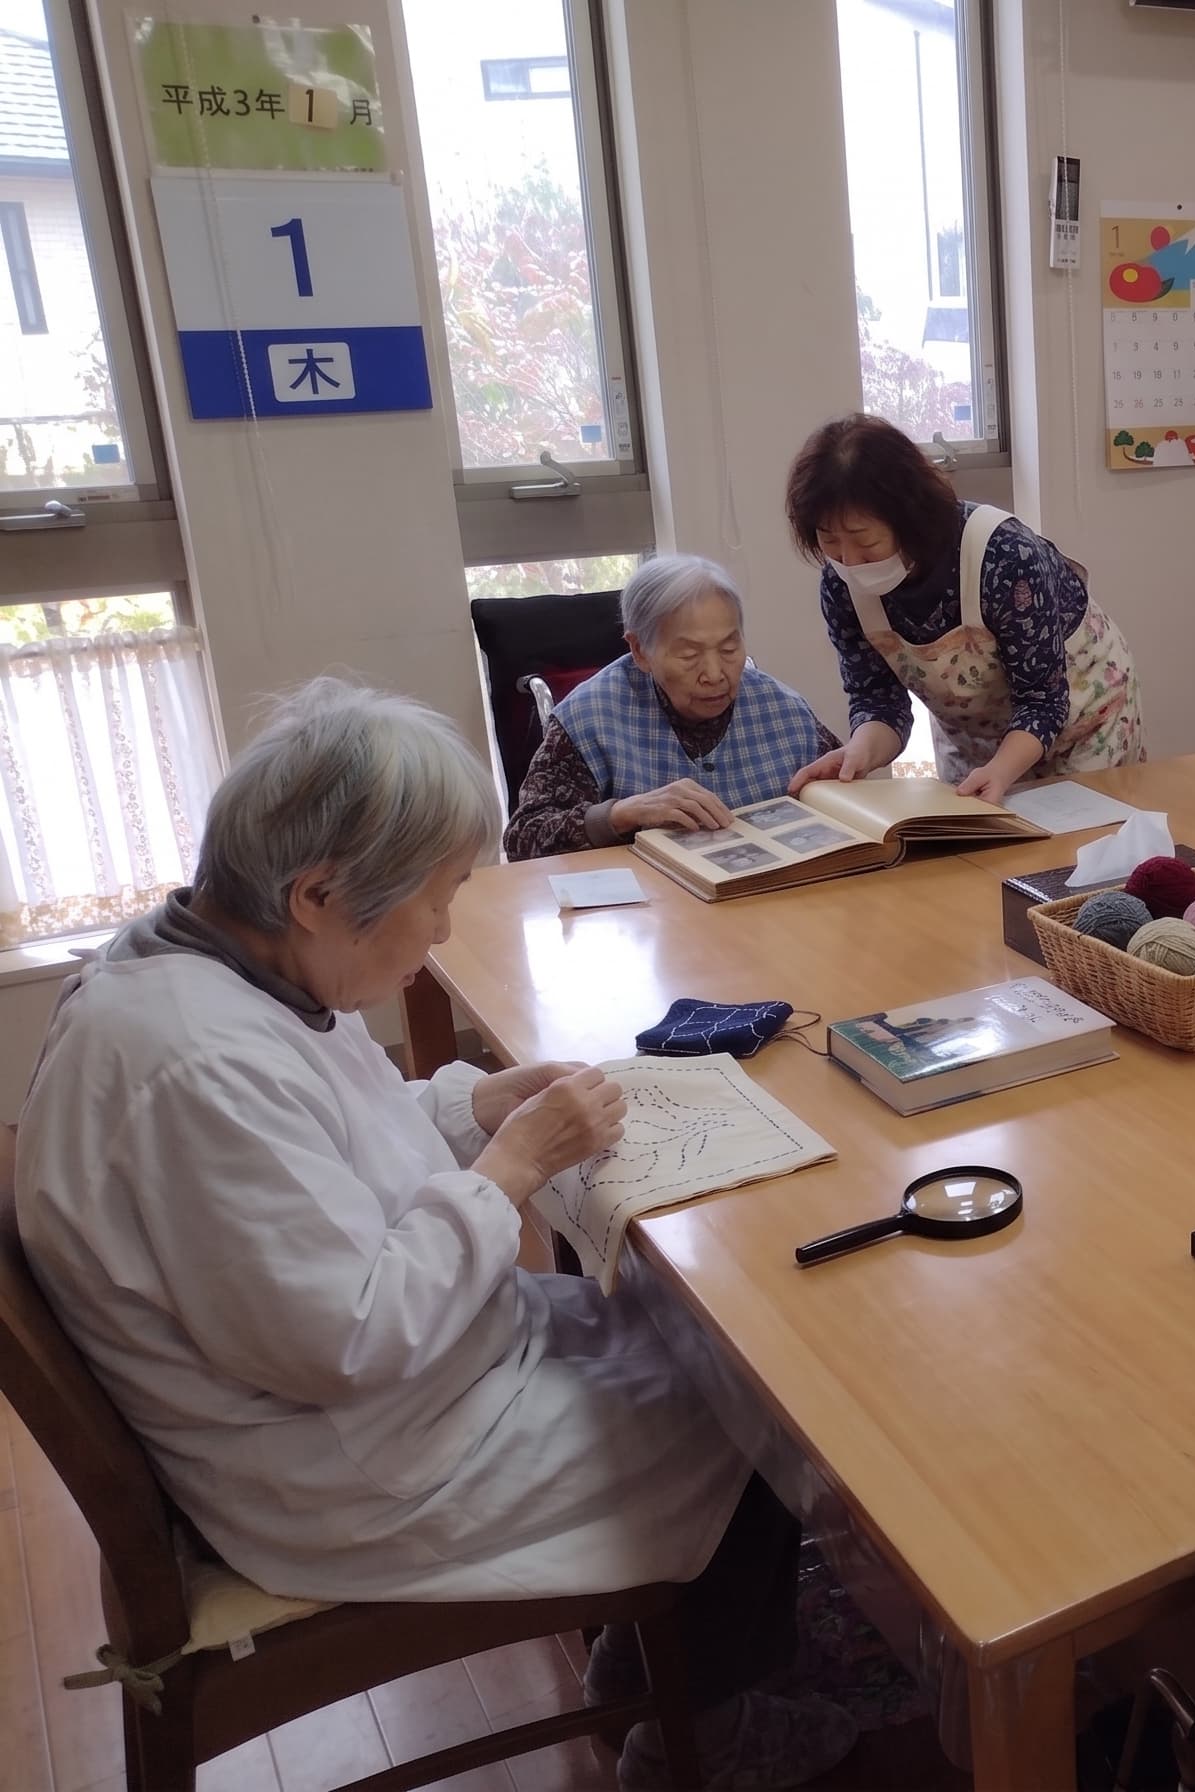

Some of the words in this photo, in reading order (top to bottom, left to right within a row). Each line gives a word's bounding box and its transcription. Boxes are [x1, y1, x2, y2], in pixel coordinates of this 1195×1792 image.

[270, 218, 314, 297] 1
[1112, 226, 1120, 249] 1
[288, 349, 341, 395] 木
